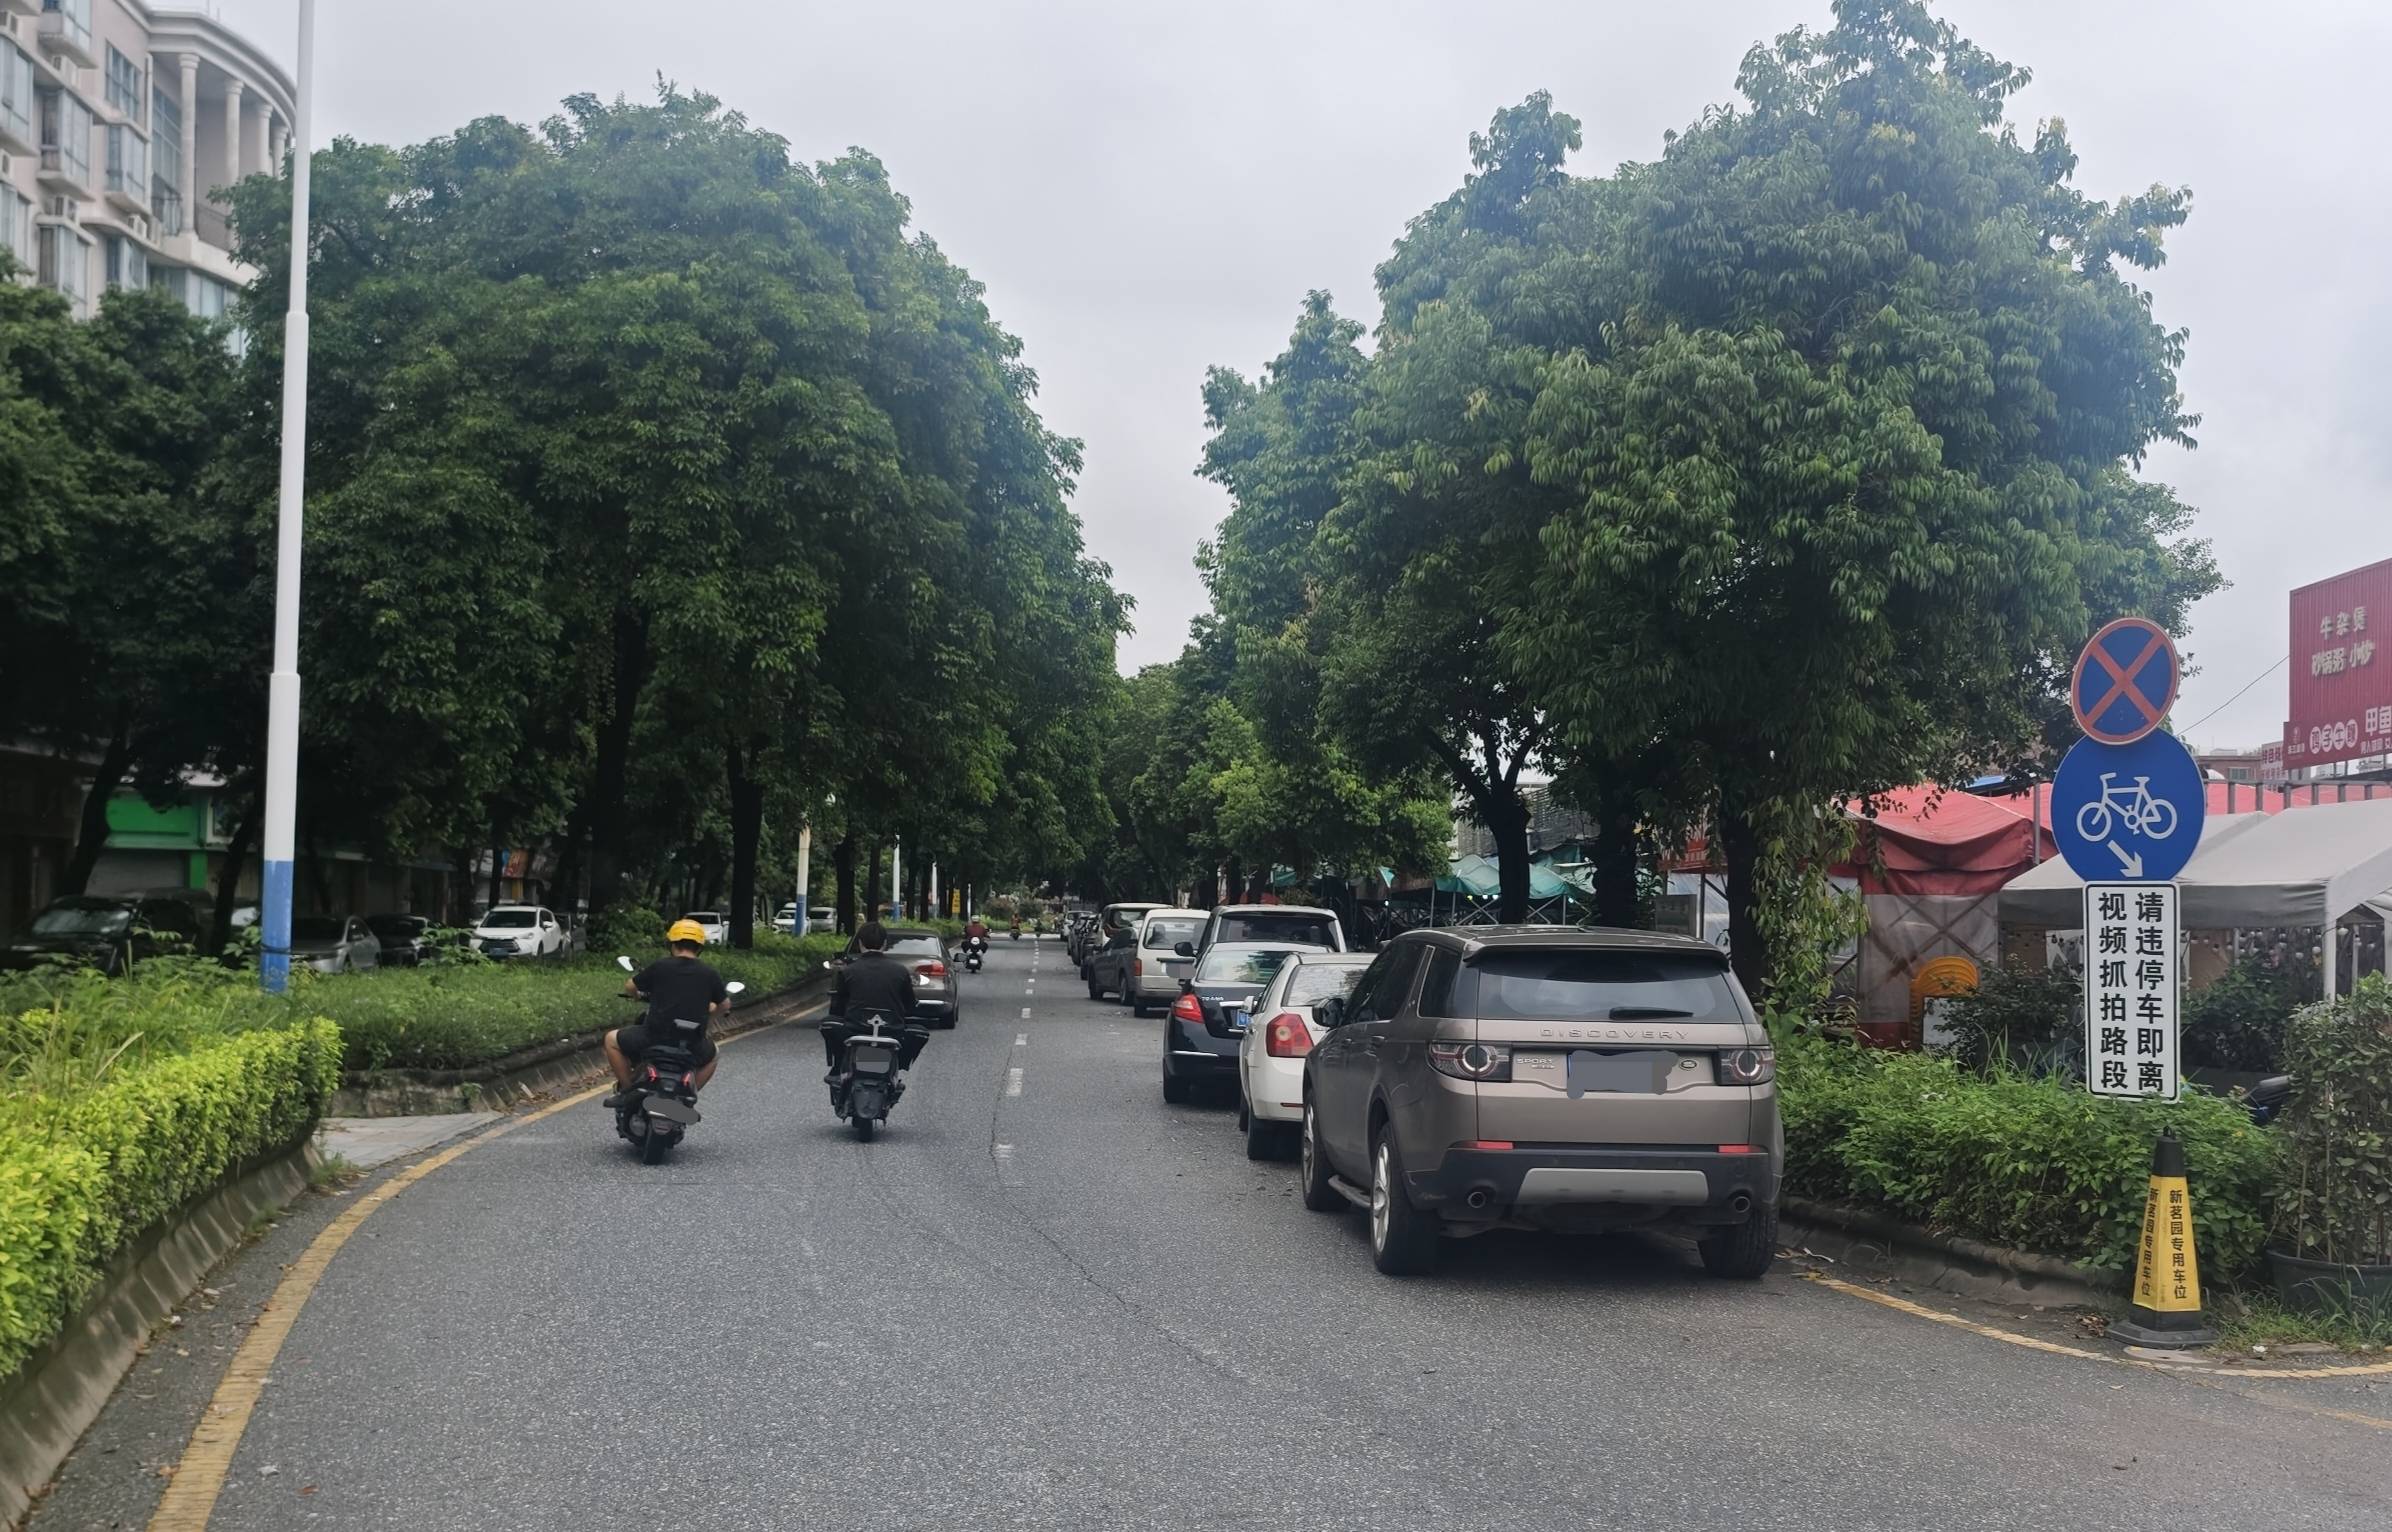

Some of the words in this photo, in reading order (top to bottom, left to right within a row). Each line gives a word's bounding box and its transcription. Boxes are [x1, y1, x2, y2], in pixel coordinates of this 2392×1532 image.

[1540, 1027, 1690, 1040] DISCOVERY
[2099, 892, 2128, 1089] 视频抓拍路段
[2135, 892, 2165, 1092] 请违停车即离
[1516, 1057, 1553, 1065] SPORT
[2169, 1189, 2187, 1300] 新茗园专用车位
